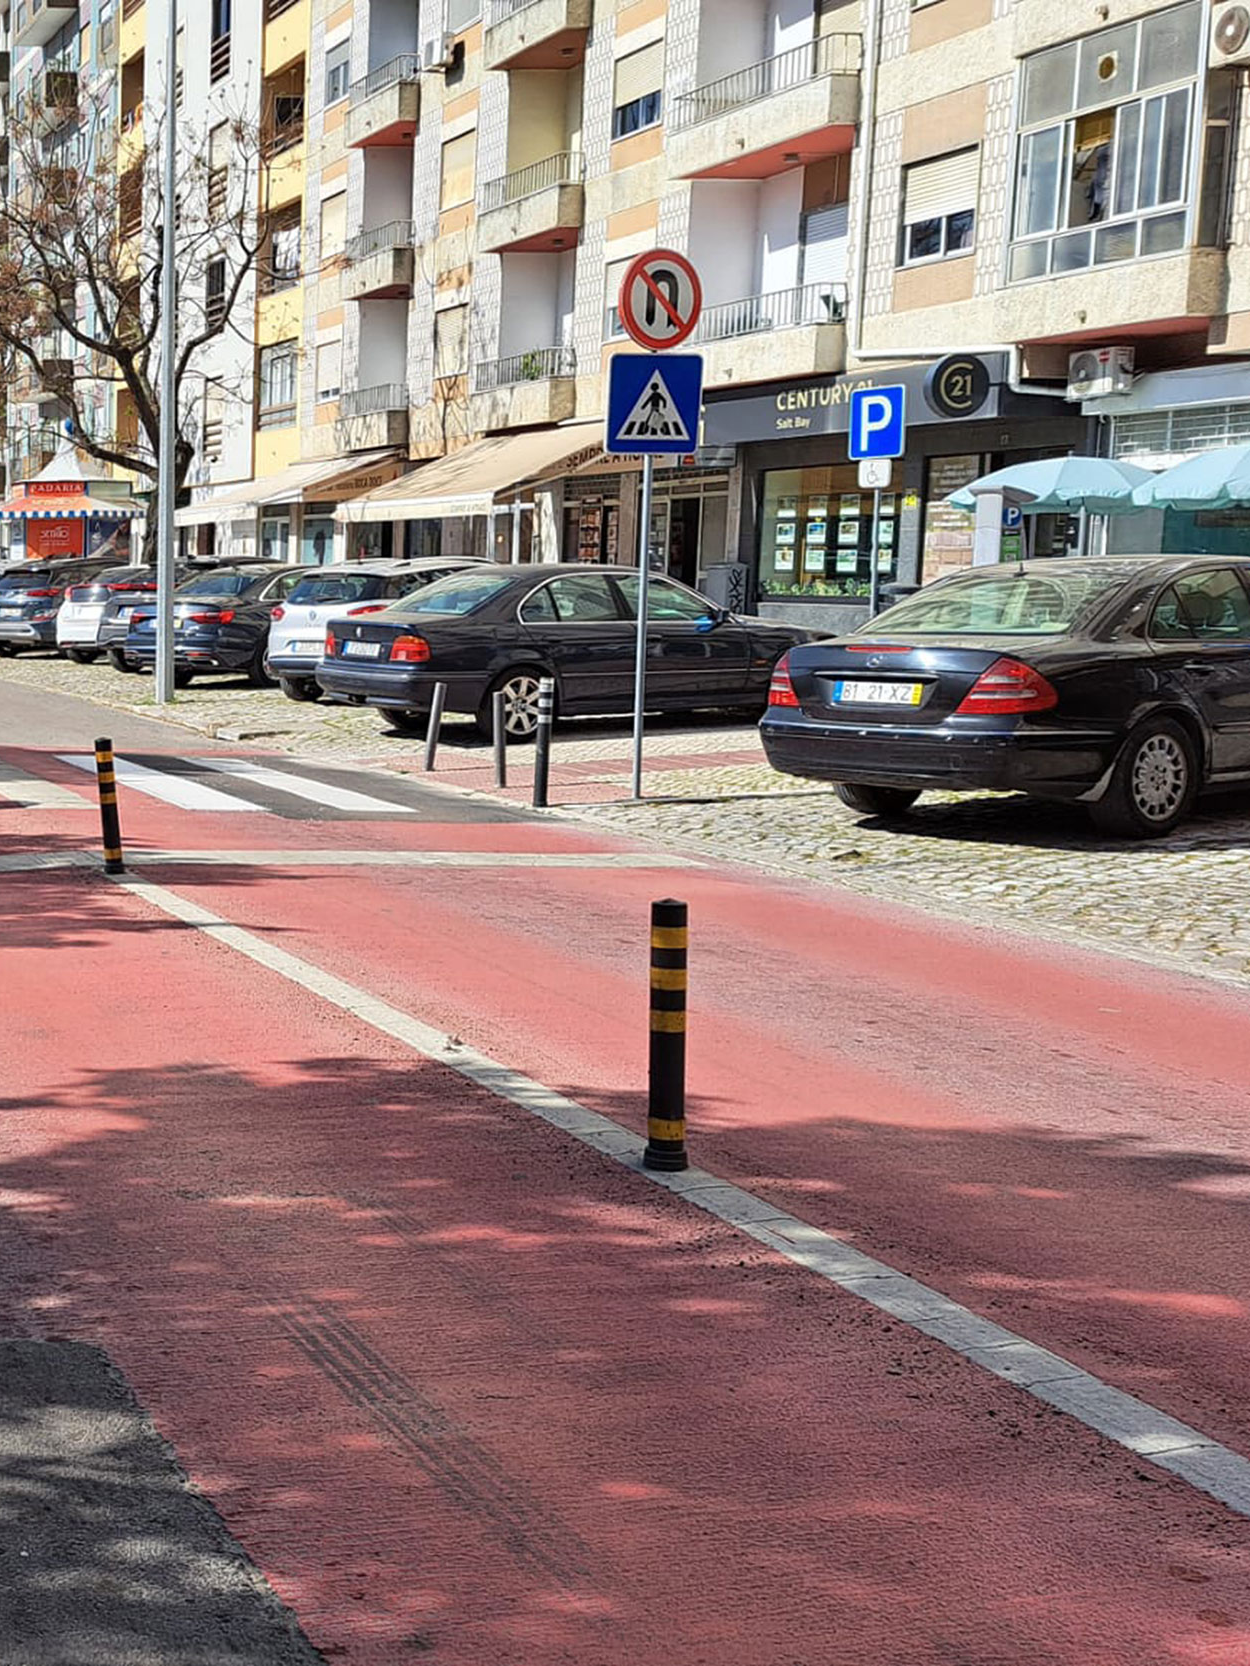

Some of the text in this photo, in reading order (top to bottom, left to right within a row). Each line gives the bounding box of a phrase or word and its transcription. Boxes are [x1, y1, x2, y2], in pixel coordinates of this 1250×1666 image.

[950, 376, 971, 396] 21
[776, 382, 854, 411] CENTURY
[776, 416, 810, 430] Salt Bay
[860, 395, 892, 451] P
[30, 484, 82, 495] PADARIA
[1007, 507, 1019, 525] P
